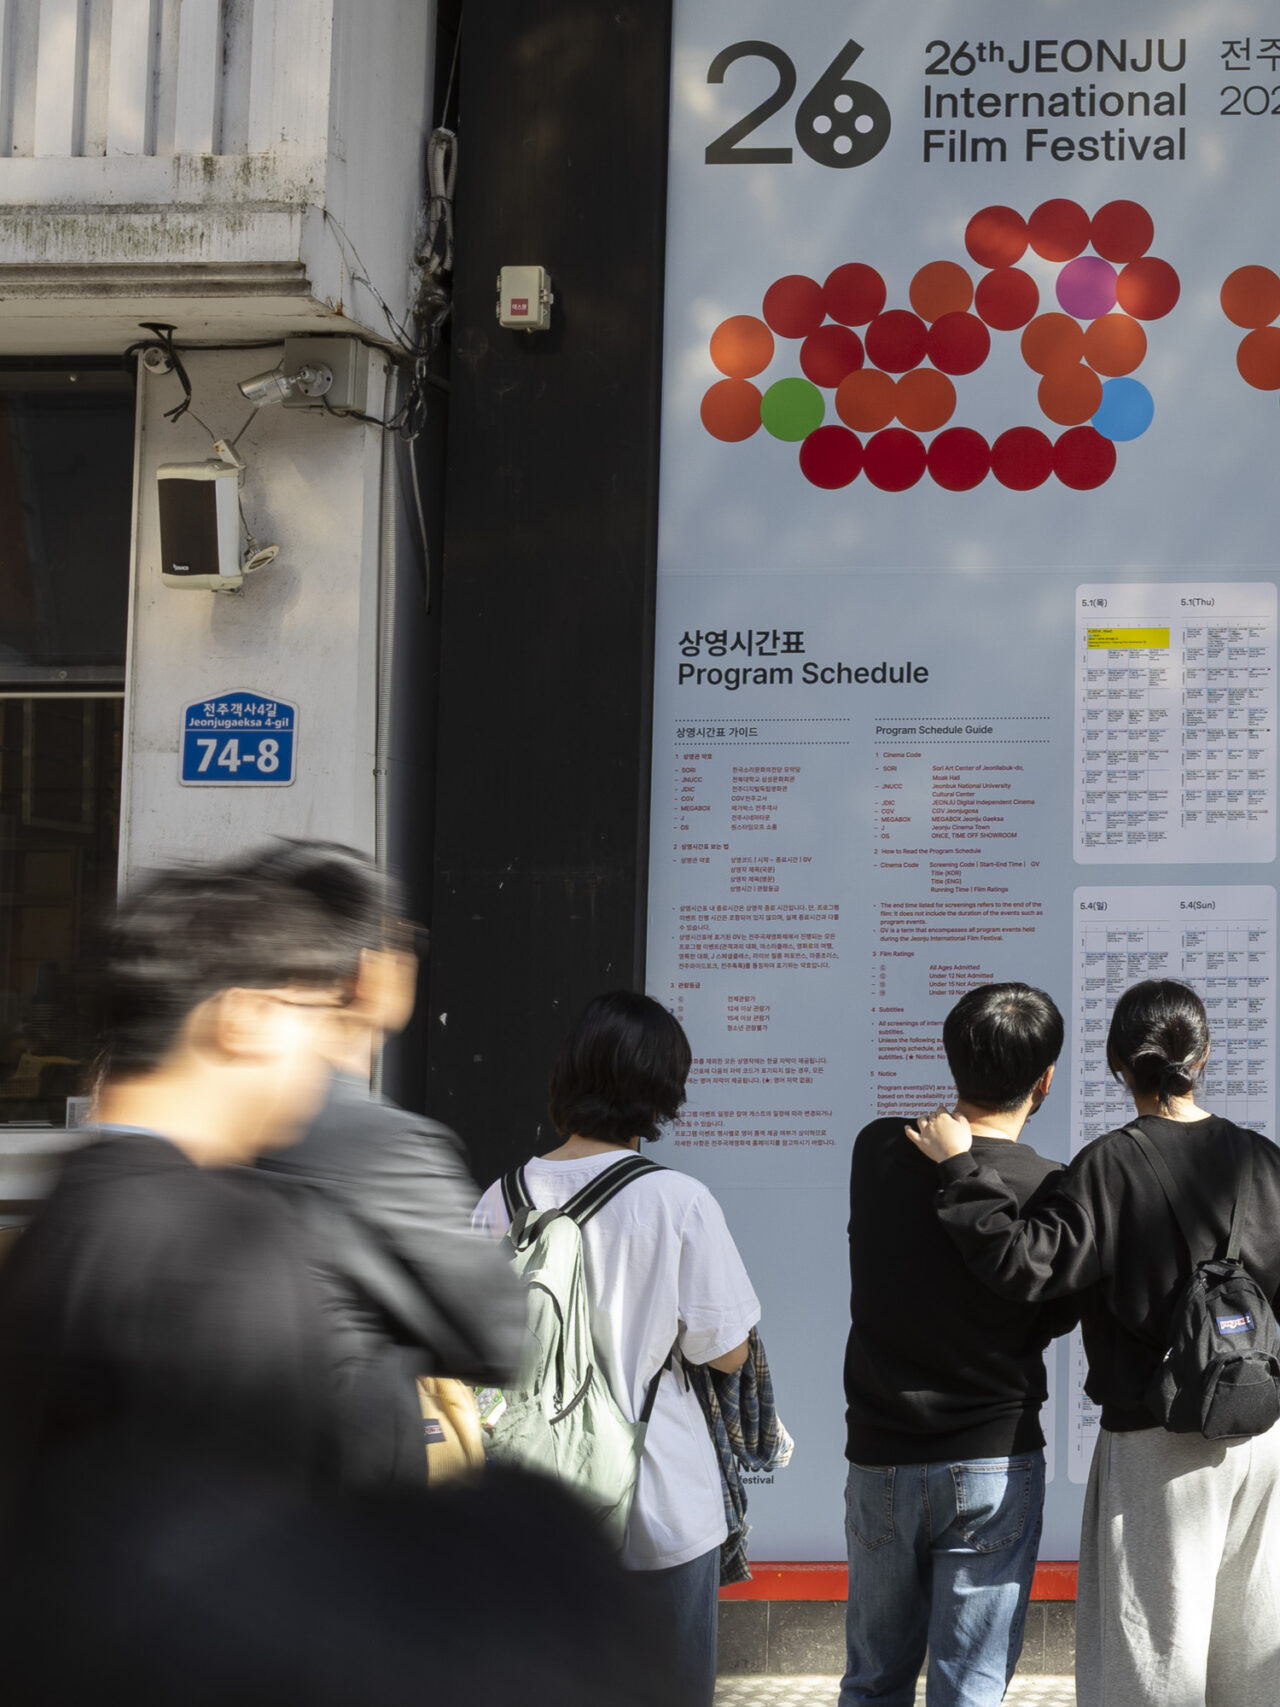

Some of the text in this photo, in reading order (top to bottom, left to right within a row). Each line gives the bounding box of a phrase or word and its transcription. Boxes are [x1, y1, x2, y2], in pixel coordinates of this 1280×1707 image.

[705, 39, 891, 169] 26
[924, 83, 1186, 118] International
[924, 127, 1185, 162] Film Festival
[1181, 598, 1215, 607] 5.1(Thu)
[678, 629, 805, 657] 상영시간표
[679, 662, 928, 691] Program Schedule
[203, 703, 277, 717] 전주객사4길
[189, 717, 289, 728] Jeonjugaeksa 4-gil
[676, 727, 758, 738] 상영시간표 가이드
[876, 725, 993, 737] Program Schedule Guide
[197, 739, 279, 772] 74-8
[1180, 901, 1215, 910] 5.4(Sun)
